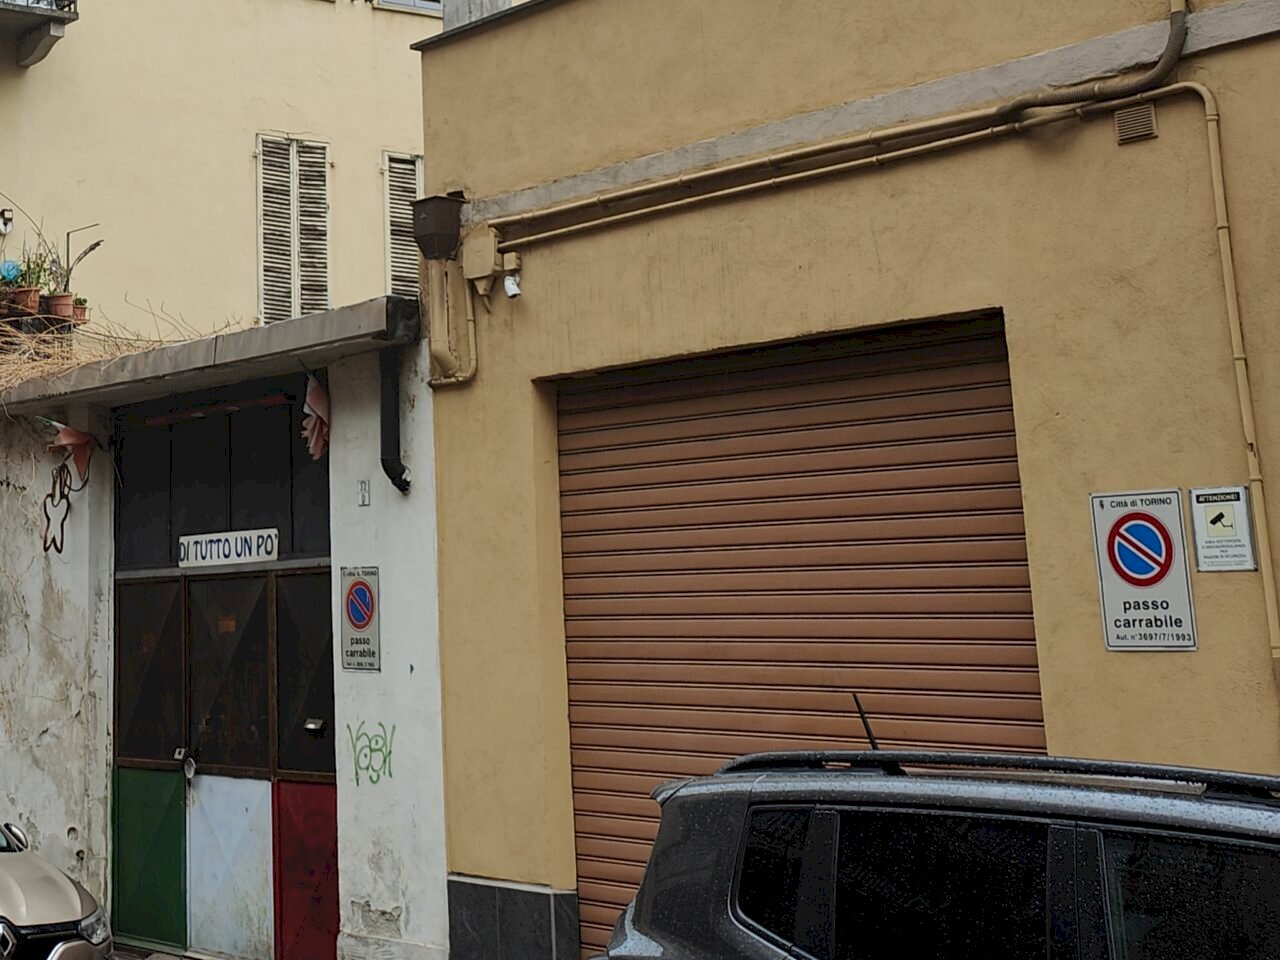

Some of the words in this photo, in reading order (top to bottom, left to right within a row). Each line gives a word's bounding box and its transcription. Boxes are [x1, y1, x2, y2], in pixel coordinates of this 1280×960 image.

[1110, 500, 1128, 509] Città
[1130, 498, 1138, 507] di
[1140, 497, 1172, 506] TORINO
[179, 541, 190, 561] DI
[193, 537, 231, 560] TUTTO
[235, 535, 253, 558] UN
[1123, 600, 1170, 614] passo
[1113, 615, 1184, 629] carrabile
[350, 637, 370, 646] passo
[1116, 633, 1130, 641] Aut.
[345, 647, 376, 658] carrabile
